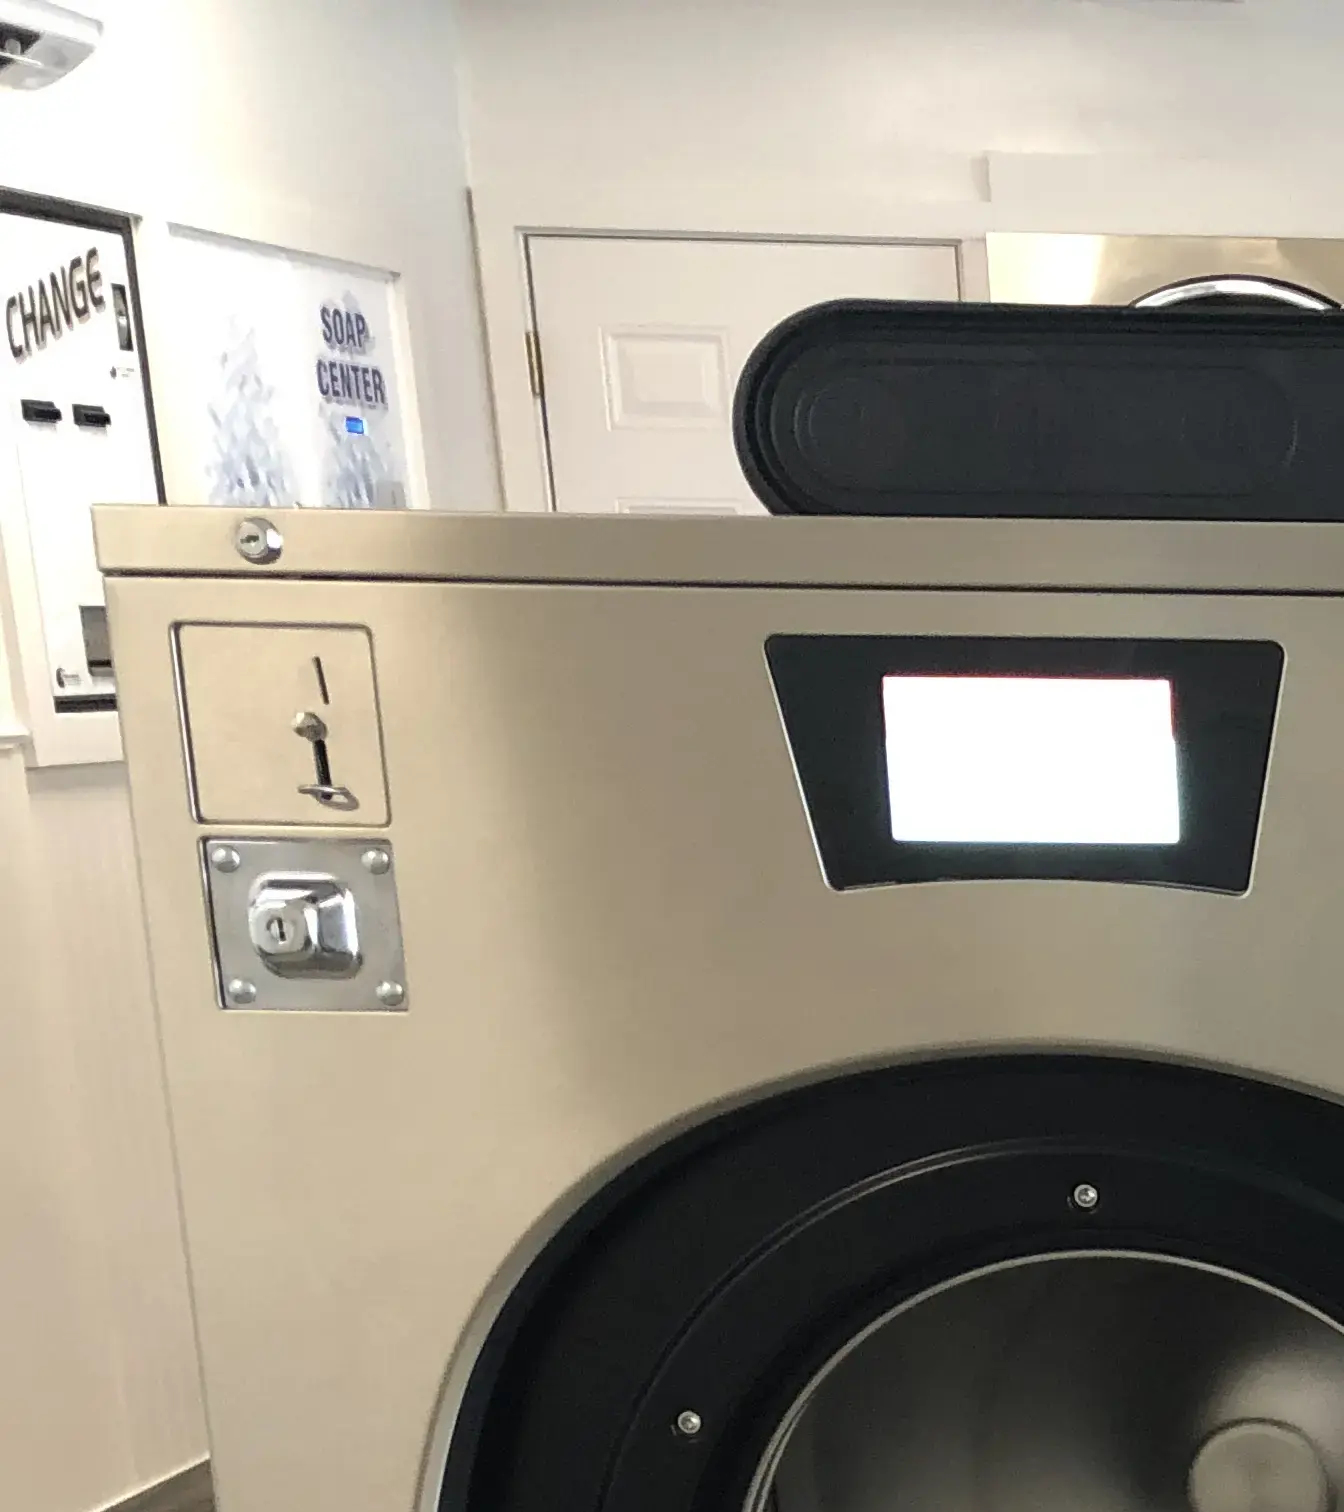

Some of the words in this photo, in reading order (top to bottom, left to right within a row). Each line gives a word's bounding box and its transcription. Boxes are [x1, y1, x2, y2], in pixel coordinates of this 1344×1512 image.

[6, 246, 105, 359] CHANGE
[320, 305, 366, 348] SOAP
[316, 358, 386, 404] CENTER
